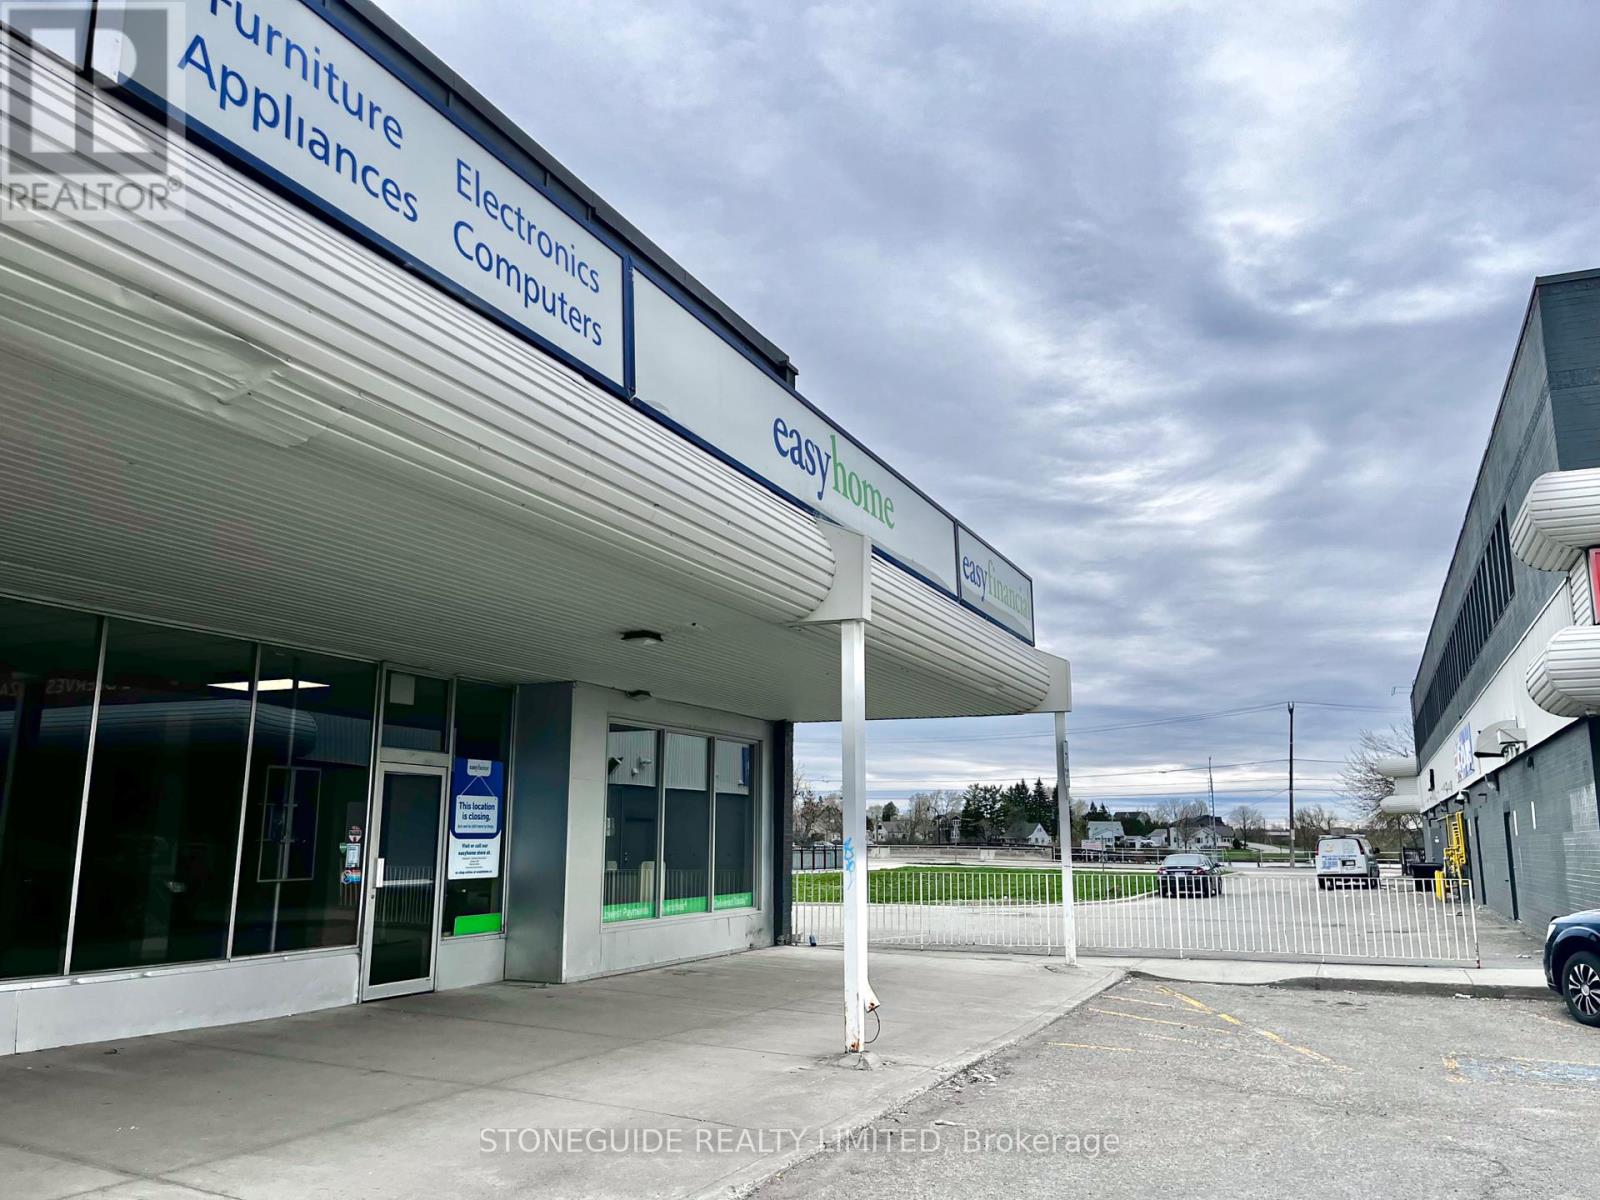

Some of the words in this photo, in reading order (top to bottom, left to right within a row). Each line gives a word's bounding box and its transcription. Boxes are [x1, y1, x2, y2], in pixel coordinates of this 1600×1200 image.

[177, 34, 418, 222] Appliances
[457, 158, 599, 293] Electronics
[453, 220, 602, 346] Computers
[773, 417, 895, 530] easyhome
[962, 556, 1030, 621] easyfinancial
[459, 801, 471, 810] This
[472, 801, 495, 810] location
[462, 811, 468, 820] is
